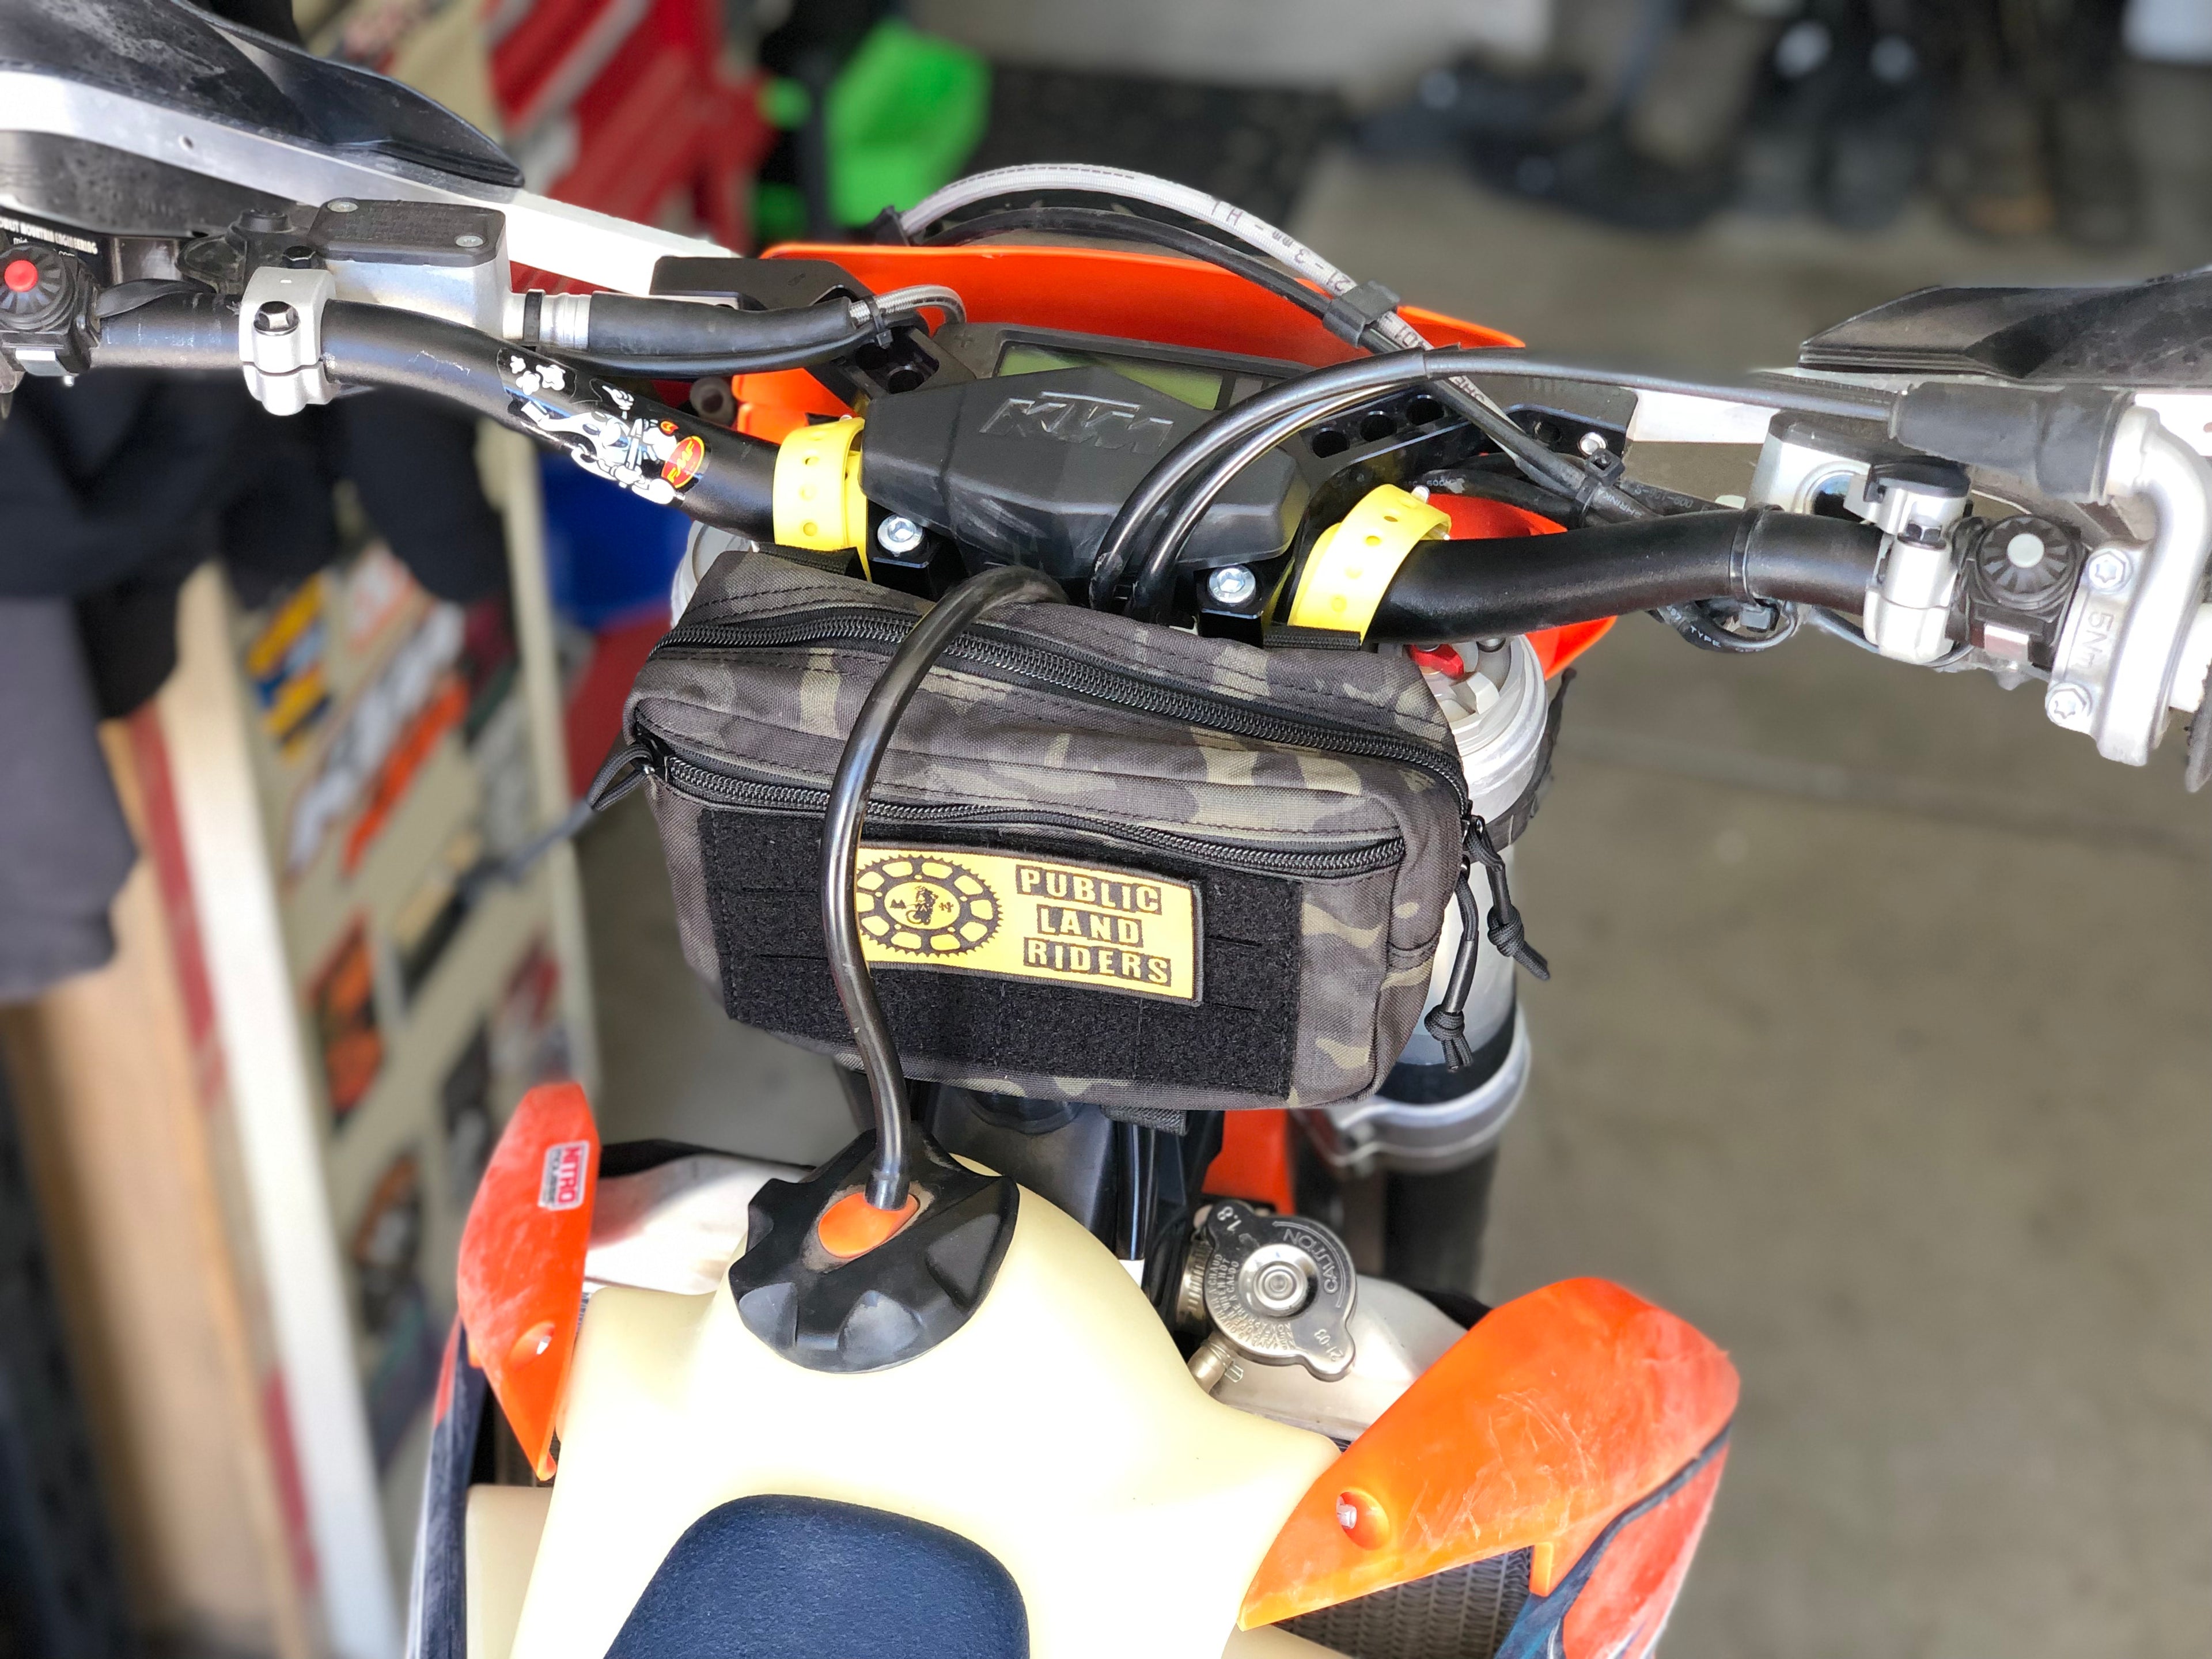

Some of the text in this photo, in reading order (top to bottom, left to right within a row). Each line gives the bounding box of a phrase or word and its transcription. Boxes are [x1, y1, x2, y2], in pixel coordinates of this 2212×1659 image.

[55, 232, 99, 255] ENGINEERING
[1272, 230, 1294, 248] mm
[1294, 248, 1311, 264] 3
[979, 391, 1174, 455] KTM
[666, 439, 695, 484] FMF
[1603, 493, 1642, 519] SHRINK
[1018, 868, 1160, 912] PUBLIC
[1040, 907, 1140, 945] LAND
[1027, 938, 1169, 984] RIDERS
[557, 1146, 582, 1204] NITRO
[1217, 1206, 1242, 1232] 1.8
[1207, 1254, 1223, 1285] CHAUD
[1217, 1257, 1230, 1278] HOT
[1226, 1260, 1239, 1293] CALDO
[1283, 1228, 1338, 1294] CAUTION
[1217, 1282, 1232, 1310] WHEN
[1314, 1328, 1343, 1362] 21-03
